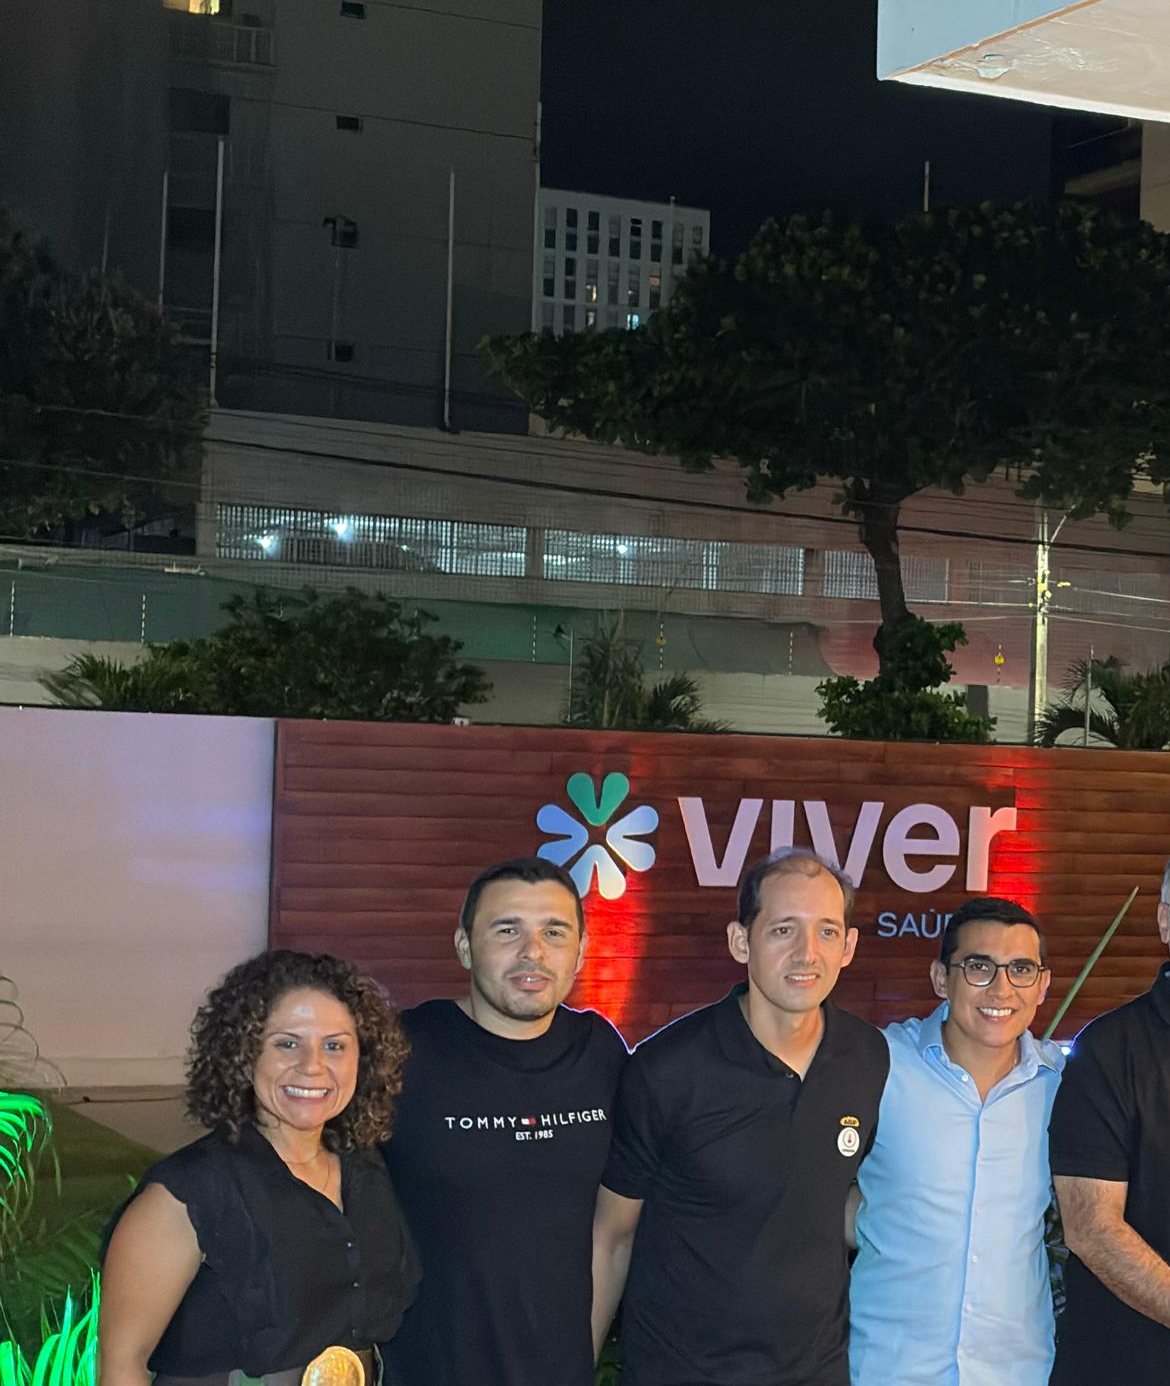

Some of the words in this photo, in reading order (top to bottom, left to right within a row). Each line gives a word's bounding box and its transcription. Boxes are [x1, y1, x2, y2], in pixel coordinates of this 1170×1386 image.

[444, 1116, 517, 1130] TOMMY
[541, 1109, 606, 1126] HILFIGER
[515, 1131, 532, 1141] EST.
[534, 1129, 554, 1140] 1985
